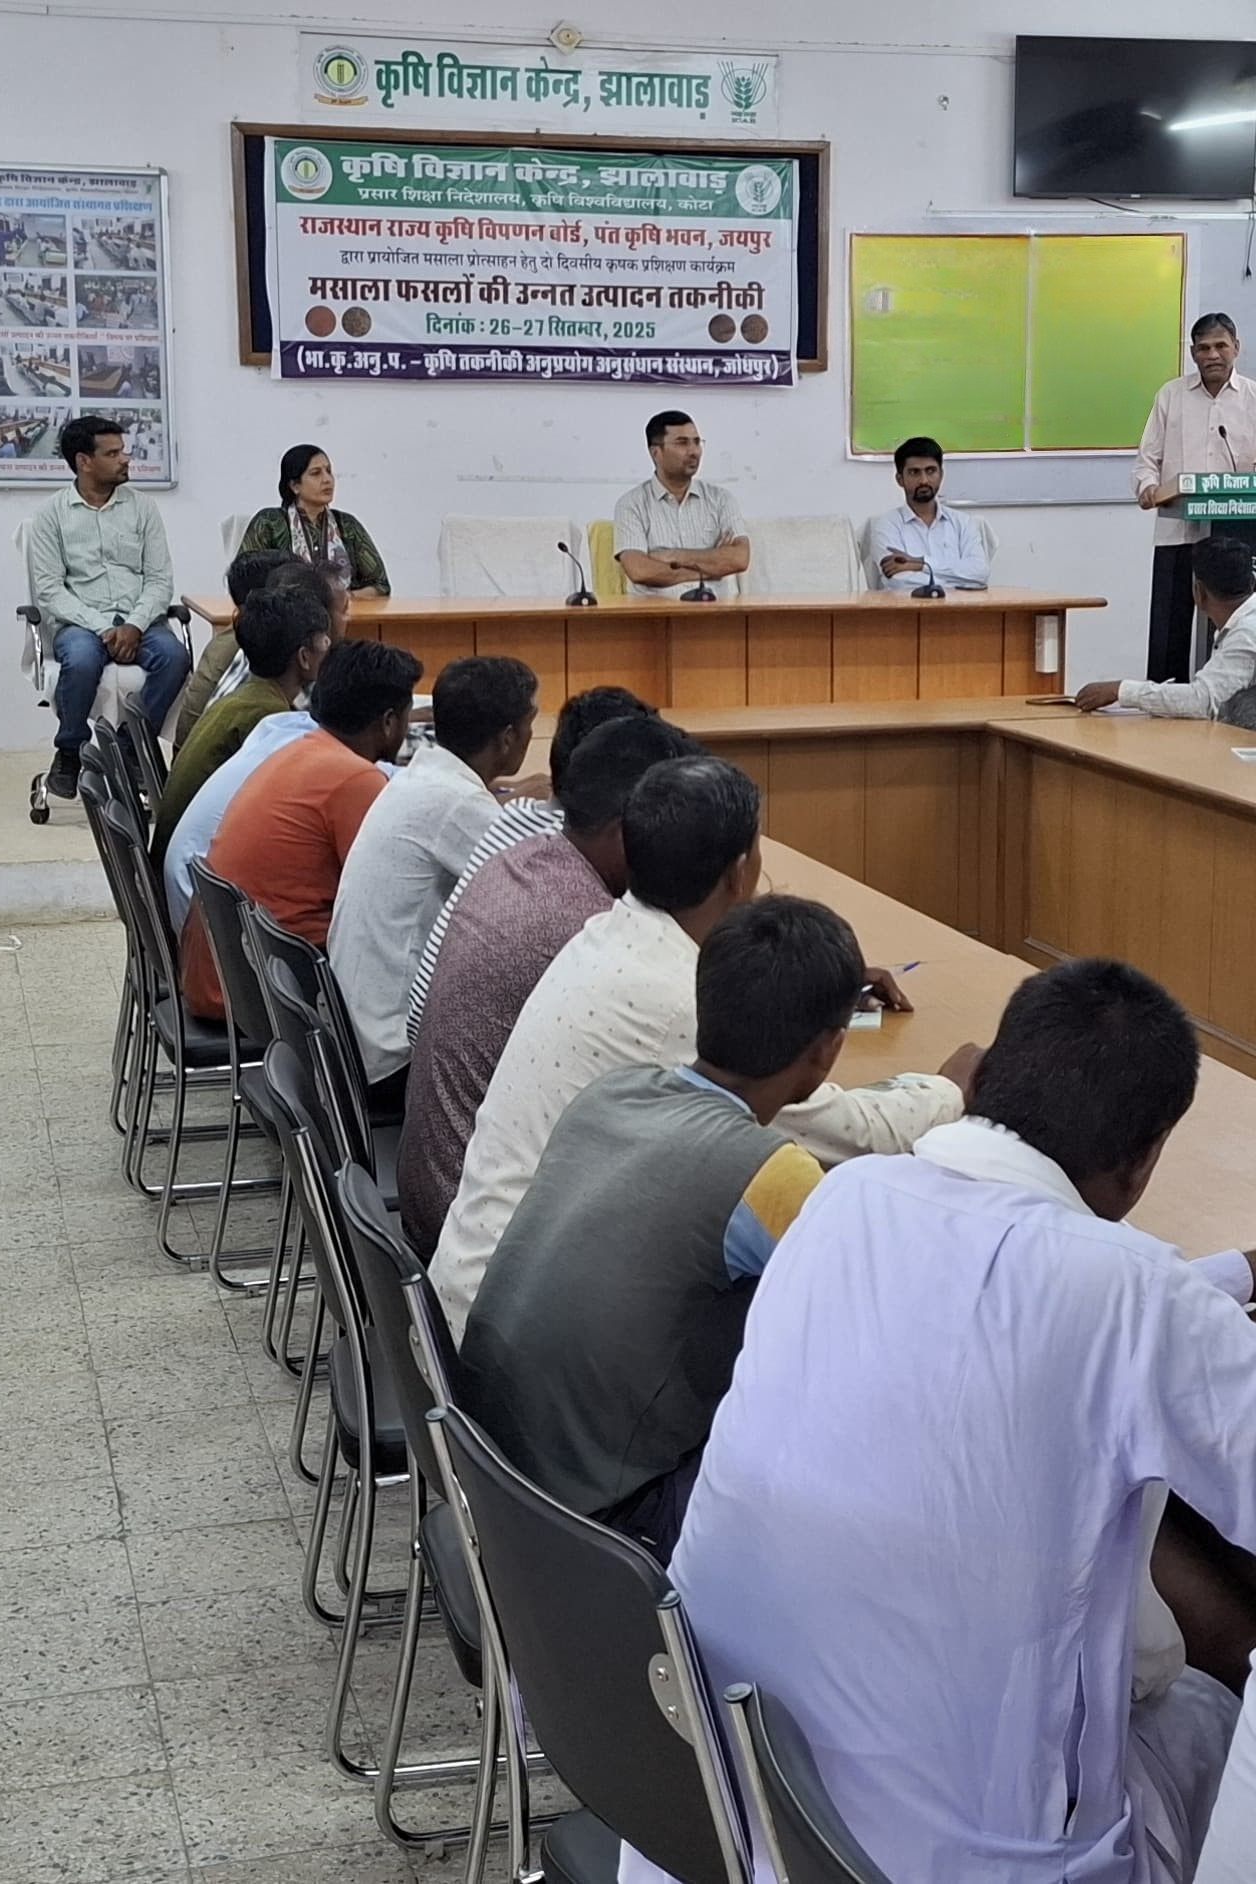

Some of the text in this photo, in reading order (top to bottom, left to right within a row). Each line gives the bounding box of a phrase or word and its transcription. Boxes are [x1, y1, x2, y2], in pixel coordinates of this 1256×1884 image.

[374, 51, 712, 120] कृषि विज्ञान केन्द्र, झालावाड़
[341, 152, 730, 195] कृषि विज्ञान केन्द्र, झालावाड़
[358, 187, 397, 201] प्रसार
[402, 186, 442, 203] शिक्षा
[446, 187, 526, 207] निदेशालय,
[531, 191, 566, 208] कृषि
[678, 194, 714, 210] कोटा
[299, 216, 773, 254] राजस्थान राज्य कृषि विपणन बोर्ड, पंत कृषि भवन, जयपुर
[339, 246, 736, 275] द्वारा प्रायोजित मसाला प्रोत्साहन हेतु दो दिवसीय कृषक प्रशिक्षण कार्यक्रम
[308, 273, 765, 310] मसाला फसलों की उन्नत उत्पादन तकनीकी
[613, 321, 656, 338] 2025
[424, 349, 457, 376] कृषि
[459, 349, 525, 372] तकनीकी
[526, 350, 593, 379] अनुप्रयोग
[596, 352, 664, 380] अनुसंधान
[665, 352, 719, 378] संस्थान,
[722, 352, 779, 380] जोधपुर)
[1201, 474, 1219, 493] कृषि
[1223, 474, 1249, 489] विज्ञान
